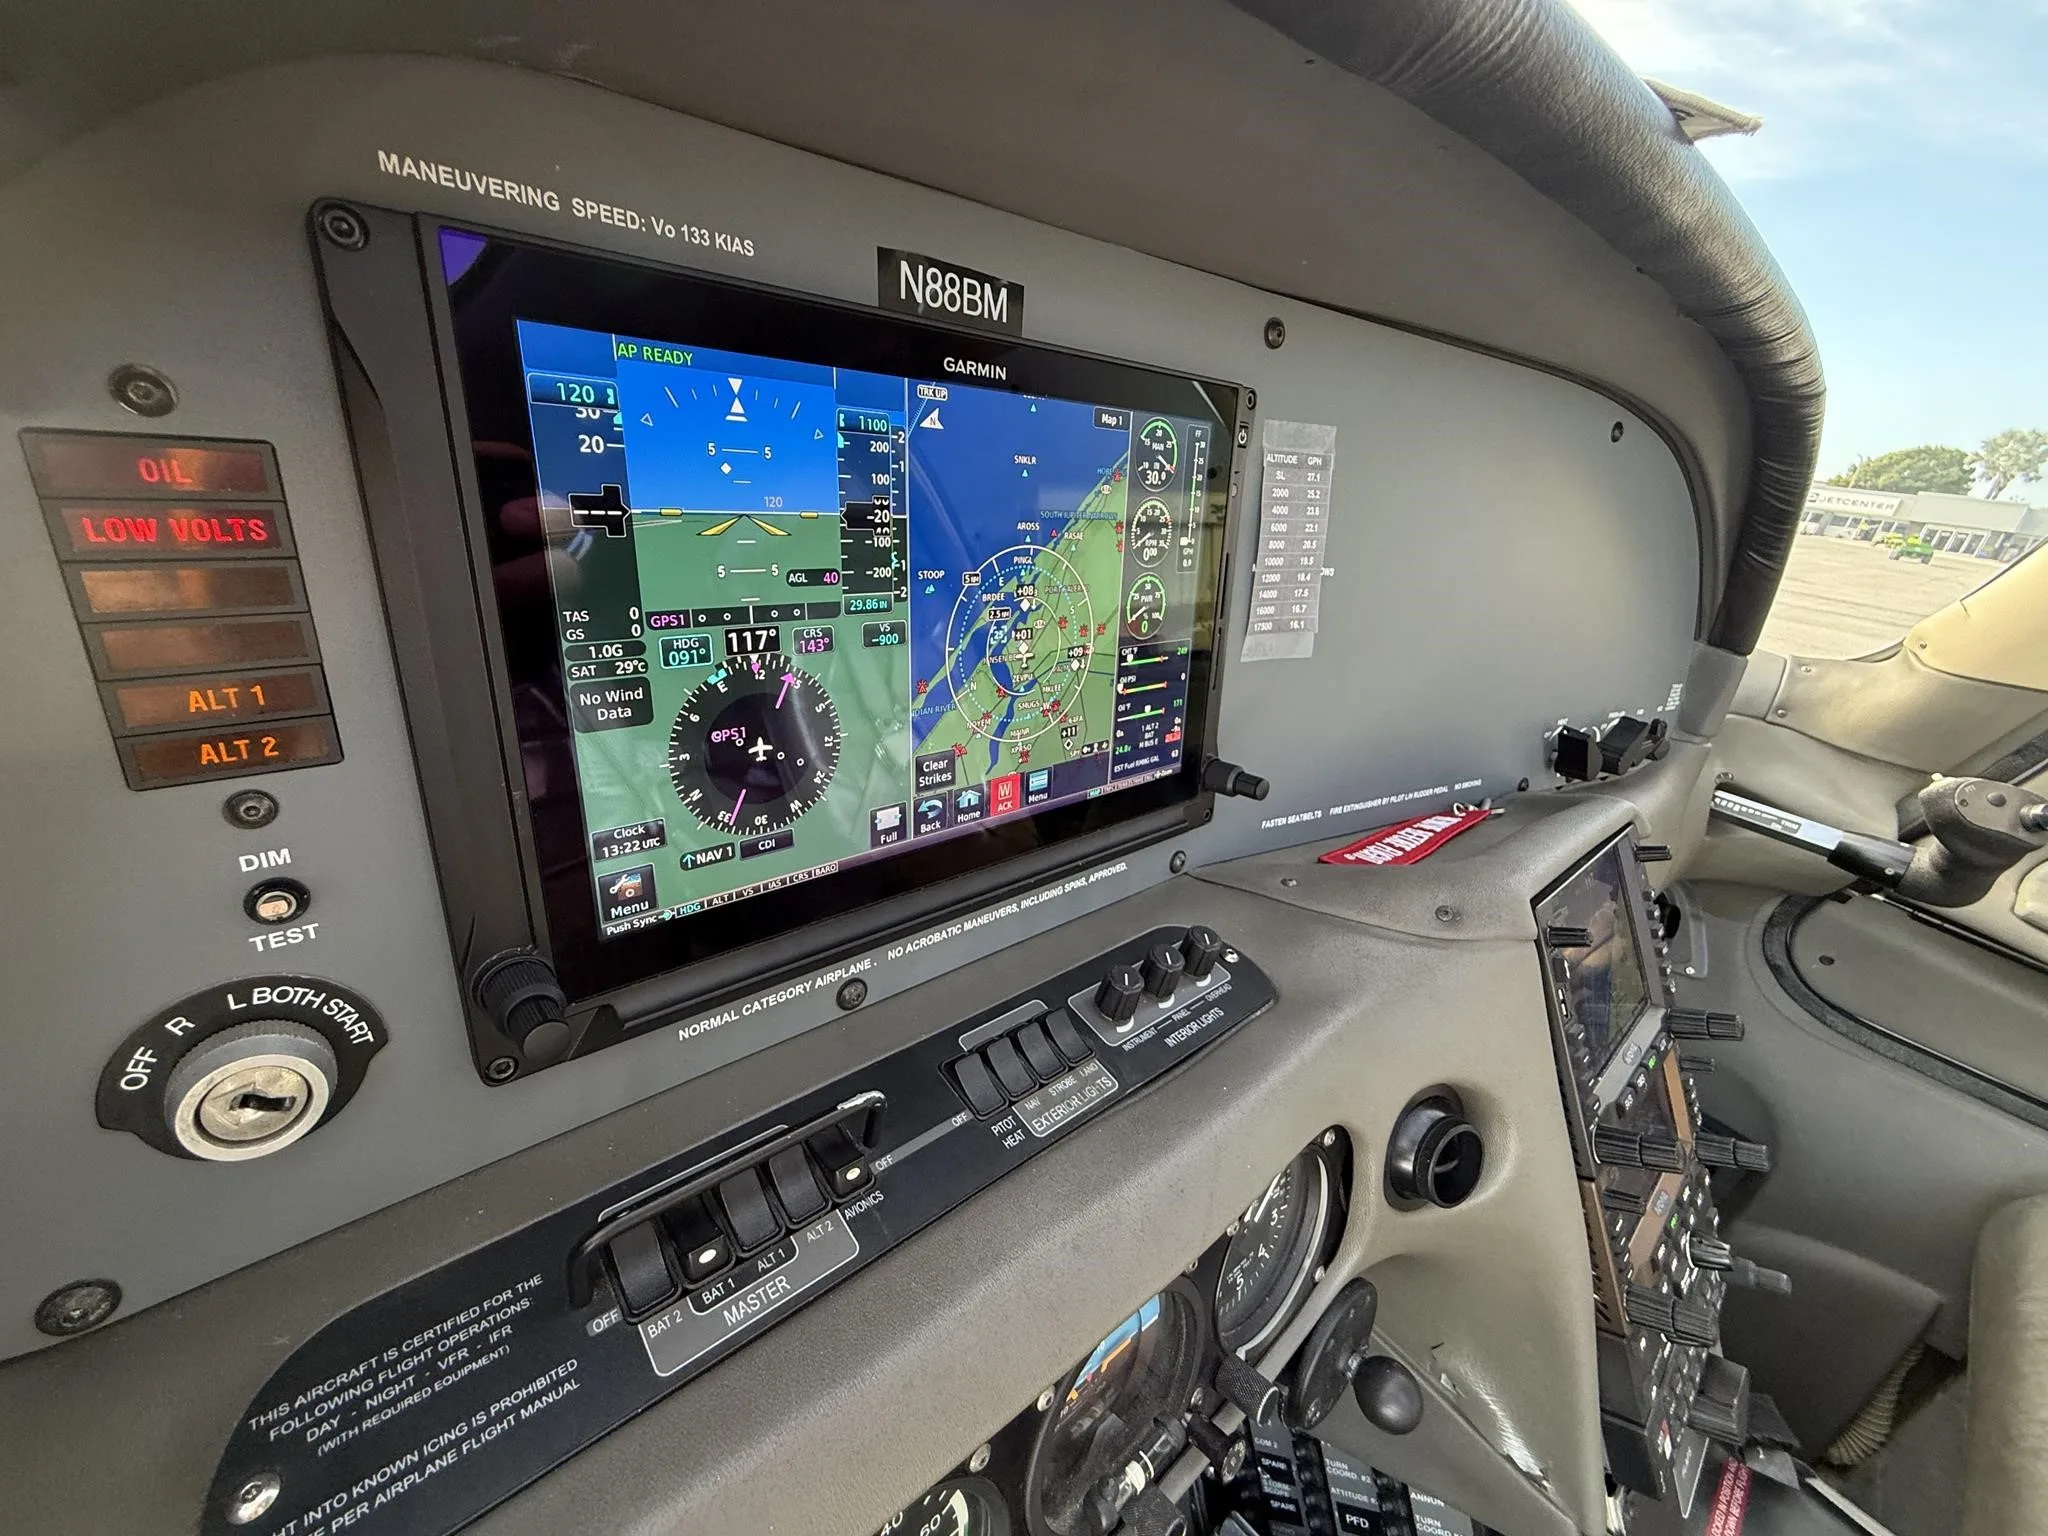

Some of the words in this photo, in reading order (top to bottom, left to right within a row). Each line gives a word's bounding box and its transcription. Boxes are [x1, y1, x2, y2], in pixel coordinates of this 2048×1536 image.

[376, 150, 560, 211] MANEUVERING
[571, 197, 647, 232] SPEED:
[651, 218, 676, 239] Vo
[681, 223, 711, 247] 133
[715, 232, 756, 257] KIAS
[899, 260, 1008, 323] N88BM
[617, 343, 638, 358] AP
[643, 346, 693, 366] READY
[943, 357, 1008, 381] GARMIN
[556, 382, 595, 404] 120
[858, 415, 888, 433] 1100
[1101, 413, 1117, 427] Map
[577, 434, 605, 454] 20
[707, 443, 716, 456] 5
[763, 446, 772, 460] 5
[869, 441, 890, 454] 200
[1014, 455, 1037, 465] SNKLR
[1267, 453, 1298, 464] ALTITUDE
[1307, 456, 1322, 466] GPH
[137, 458, 193, 485] OIL
[871, 473, 890, 485] 100
[1275, 471, 1286, 480] SL
[1272, 488, 1289, 498] 2000
[763, 496, 783, 508] 120
[1272, 505, 1289, 515] 4000
[1819, 496, 1895, 510] JETCENTER
[82, 516, 157, 543] LOW
[168, 517, 269, 543] VOLTS
[1017, 522, 1040, 531] AROSS
[1270, 523, 1288, 532] 6000
[717, 565, 726, 578] 5
[770, 563, 779, 576] 5
[788, 572, 808, 584] AGL
[823, 571, 839, 584] 40
[917, 570, 945, 580] STOOP
[1259, 590, 1278, 599] 14000
[1294, 588, 1309, 597] 17.5
[849, 599, 878, 611] 29.86
[563, 610, 590, 623] TAS
[629, 607, 640, 620] 0
[650, 614, 685, 628] GPS1
[566, 628, 585, 641] GS
[631, 624, 641, 637] 0
[803, 629, 823, 638] CRS
[879, 623, 891, 632] VS
[673, 637, 700, 649] HDG
[728, 628, 776, 653] 117°
[588, 644, 624, 659] 1.0G
[571, 665, 597, 678] SAT
[717, 682, 728, 693] E
[187, 687, 239, 713] ALT
[249, 685, 266, 706] 1
[580, 693, 601, 706] No
[605, 687, 644, 703] Wind
[597, 707, 632, 721] Data
[200, 739, 250, 765] ALT
[261, 736, 280, 757] 2
[922, 759, 949, 772] Clear
[918, 772, 952, 787] Strikes
[997, 801, 1013, 812] ACK
[1028, 792, 1048, 804] Menu
[1329, 805, 1343, 816] FIRE
[1343, 798, 1382, 813] EXTINGUISHER
[1389, 793, 1405, 804] PILOT
[957, 810, 981, 823] Home
[1261, 816, 1287, 829] FASTEN
[1287, 810, 1323, 825] SEATBELTS
[613, 825, 645, 840] Clock
[920, 820, 941, 833] Back
[758, 839, 776, 851] CDI
[880, 831, 898, 845] Full
[601, 841, 641, 859] 13:22
[642, 837, 660, 849] UTC
[238, 848, 292, 873] DIM
[696, 848, 724, 866] NAV
[679, 902, 702, 915] HDG
[711, 894, 729, 906] ALT
[742, 887, 754, 897] VS
[768, 879, 782, 889] IAS
[792, 871, 809, 883] CRS
[815, 862, 838, 875] BARO
[610, 899, 650, 919] Menu
[887, 947, 904, 961] NO
[905, 924, 963, 956] ACROBATIC
[963, 901, 1020, 933] MANEUVERS,
[1020, 884, 1064, 910] INCLUDING
[1063, 877, 1088, 895] SPINS,
[1087, 861, 1128, 886] APPROVED.
[606, 921, 631, 937] Push
[632, 913, 658, 930] Sync
[249, 922, 320, 952] TEST
[1204, 983, 1232, 1003] OVERHEAD
[678, 1010, 740, 1041] NORMAL
[741, 979, 813, 1017] CATEGORY
[1172, 1008, 1192, 1023] PANEL
[1164, 1020, 1201, 1048] INTERIOR
[1198, 1007, 1225, 1028] LIGHTS
[119, 1046, 158, 1091] OFF
[164, 1016, 197, 1037] R
[227, 993, 248, 1010] L
[252, 985, 327, 1009] BOTH
[323, 998, 375, 1046] START
[1122, 1026, 1159, 1052] INSTRUMENT
[1024, 1096, 1041, 1111] NAV
[1048, 1076, 1078, 1097] STROBE
[1031, 1095, 1082, 1133] EXTERIOR
[1077, 1076, 1112, 1106] LIGHTS
[951, 1112, 968, 1128] OFF
[991, 1115, 1017, 1137] PITOT
[1002, 1131, 1027, 1150] HEAT
[875, 1154, 894, 1171] OFF
[844, 1190, 885, 1221] AVIONICS
[805, 1226, 825, 1243] ALT
[824, 1220, 834, 1232] 2
[1257, 1242, 1267, 1258] 4
[756, 1254, 777, 1273] ALT
[779, 1248, 787, 1259] 1
[701, 1284, 726, 1305] BAT
[728, 1277, 736, 1289] 1
[722, 1275, 792, 1326] MASTER
[592, 1309, 619, 1333] OFF
[647, 1316, 672, 1339] BAT
[672, 1310, 683, 1323] 2
[248, 1403, 290, 1431] THIS
[294, 1356, 379, 1408] AIRCRAFT
[382, 1347, 399, 1363] IS
[401, 1307, 481, 1353] CERTIFIED
[483, 1288, 514, 1310] FOR
[514, 1273, 544, 1292] THE
[269, 1378, 375, 1442] FOLLOWING
[378, 1347, 434, 1387] FLIGHT
[437, 1296, 534, 1352] OPERATIONS:
[306, 1416, 343, 1443] DAY
[365, 1375, 416, 1410] NIGHT
[437, 1348, 470, 1371] VFR
[489, 1324, 513, 1345] IFR
[317, 1427, 360, 1457] (WITH
[363, 1388, 433, 1434] REQUIRED
[433, 1344, 511, 1395] EQUIPMENT)
[303, 1492, 347, 1526] INTO
[352, 1450, 419, 1497] KNOWN
[423, 1421, 469, 1453] ICING
[471, 1411, 487, 1428] IS
[489, 1358, 579, 1418] PROHIBITED
[331, 1503, 370, 1536] PER
[374, 1449, 459, 1508] AIRPLANE
[461, 1416, 517, 1459] FLIGHT
[520, 1377, 581, 1420] MANUAL
[1324, 1458, 1349, 1470] TURN
[1330, 1487, 1369, 1503] ATTITUDE
[1345, 1514, 1369, 1529] PFD
[1415, 1514, 1442, 1528] TURN
